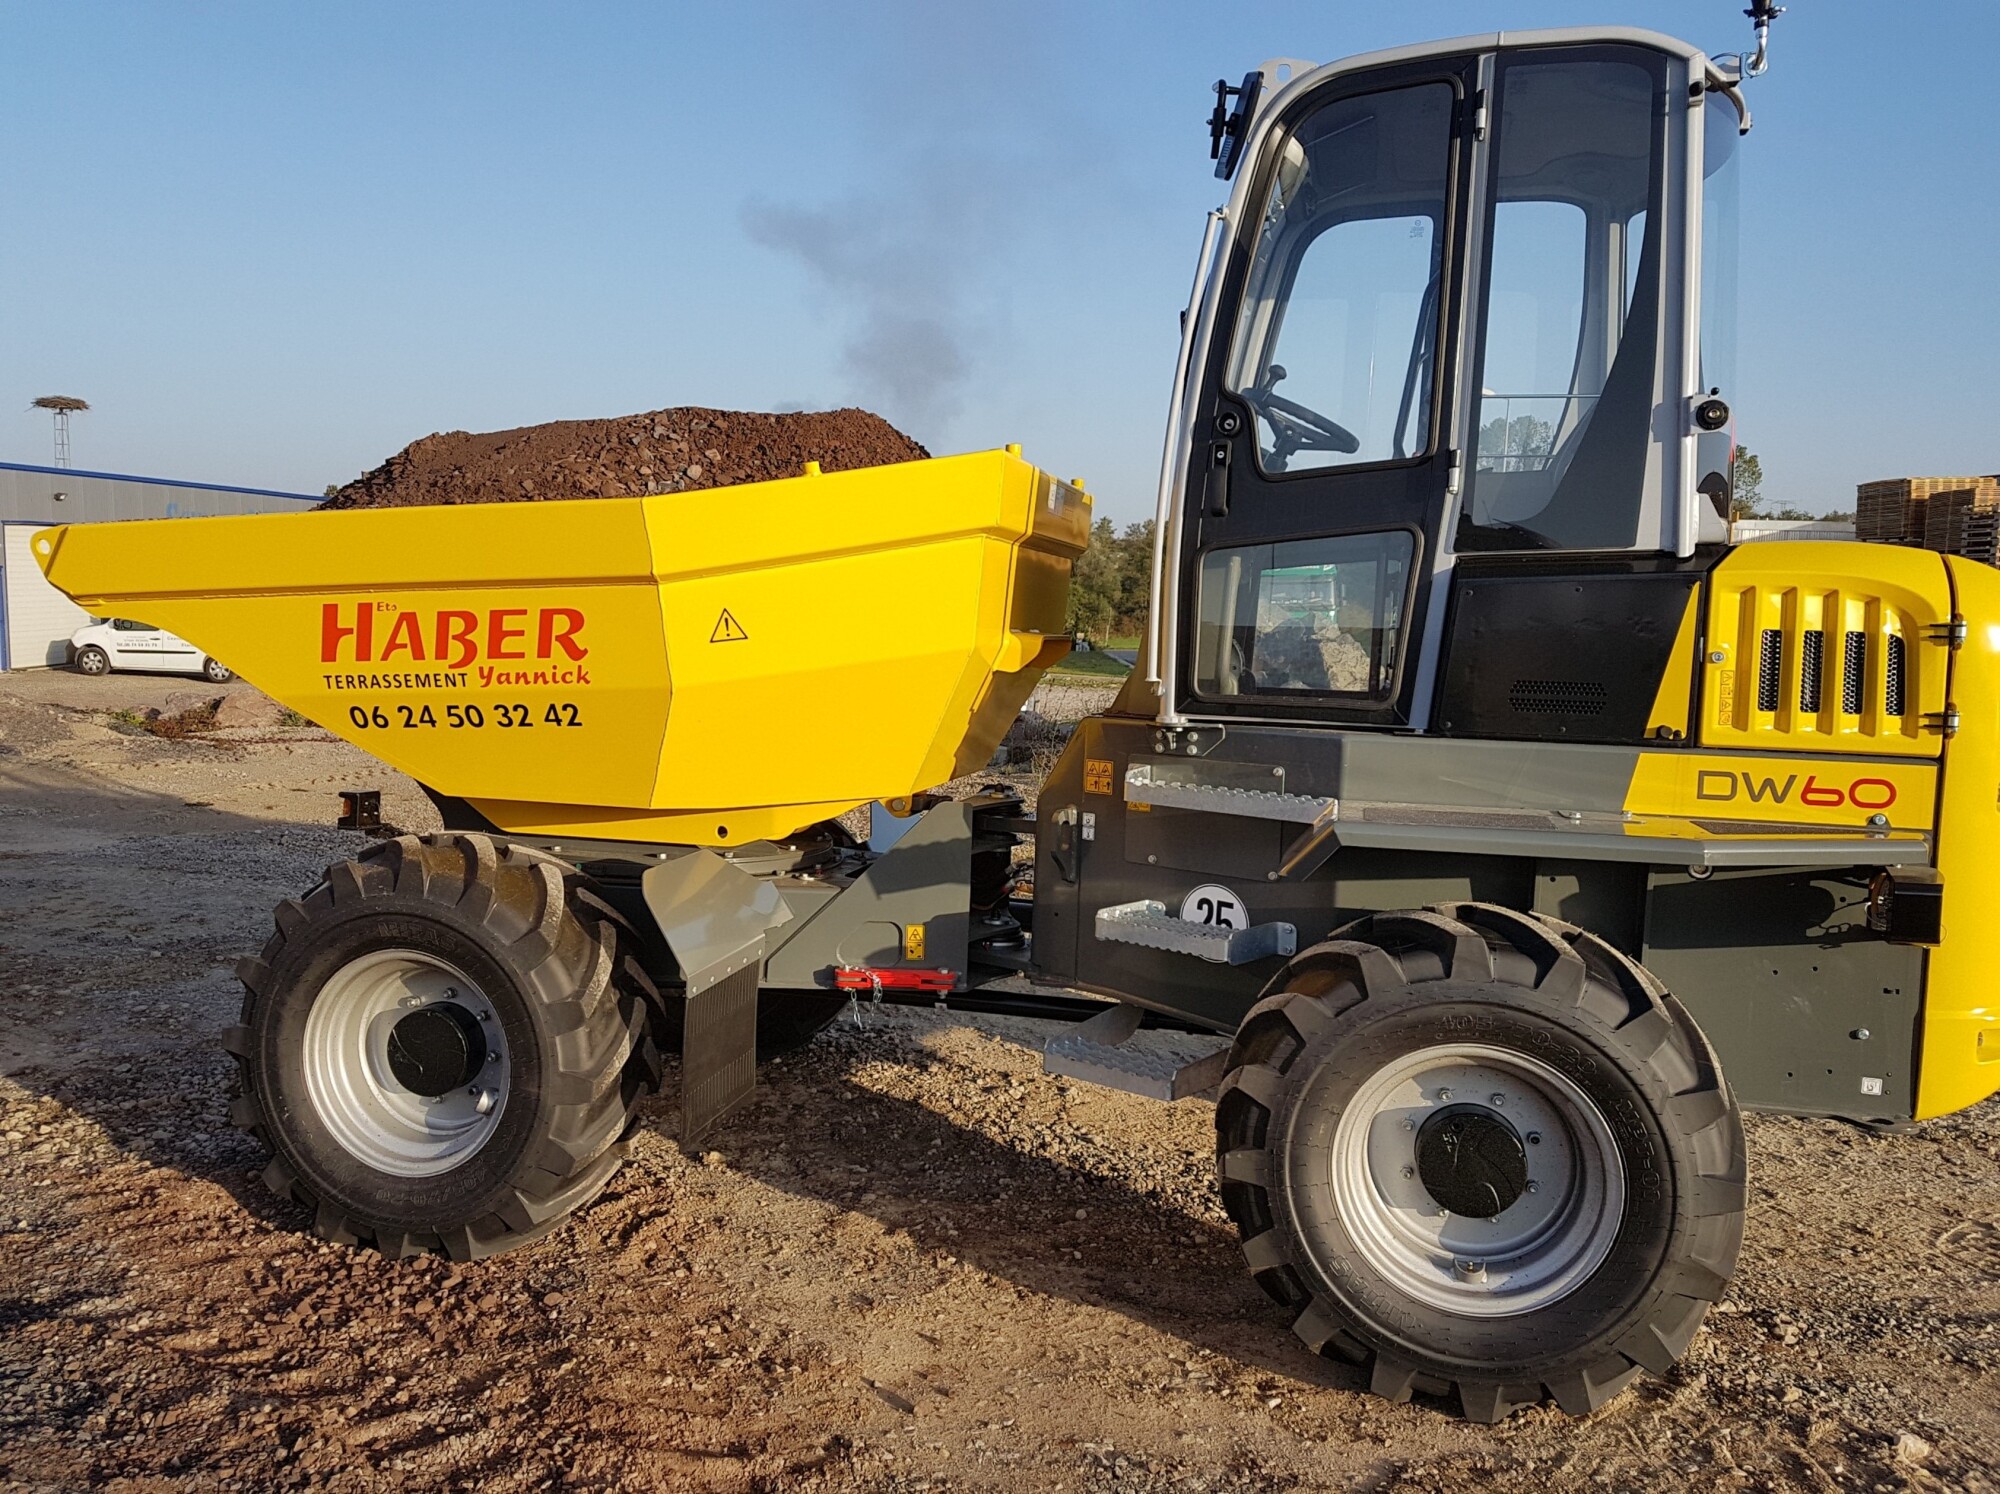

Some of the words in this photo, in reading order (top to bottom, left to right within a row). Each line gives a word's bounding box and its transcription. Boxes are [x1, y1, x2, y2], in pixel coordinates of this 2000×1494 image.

[376, 601, 397, 612] Ets
[321, 602, 589, 669] HABER
[323, 673, 468, 690] TERRASSEMENT
[478, 664, 591, 688] Yannick
[349, 705, 390, 729] 06
[397, 705, 437, 728] 24
[446, 704, 484, 728] 50
[493, 704, 533, 727] 32
[544, 703, 583, 727] 42
[1697, 770, 1897, 809] DW60
[1196, 897, 1235, 928] 25
[1328, 1254, 1416, 1336] MITAS
